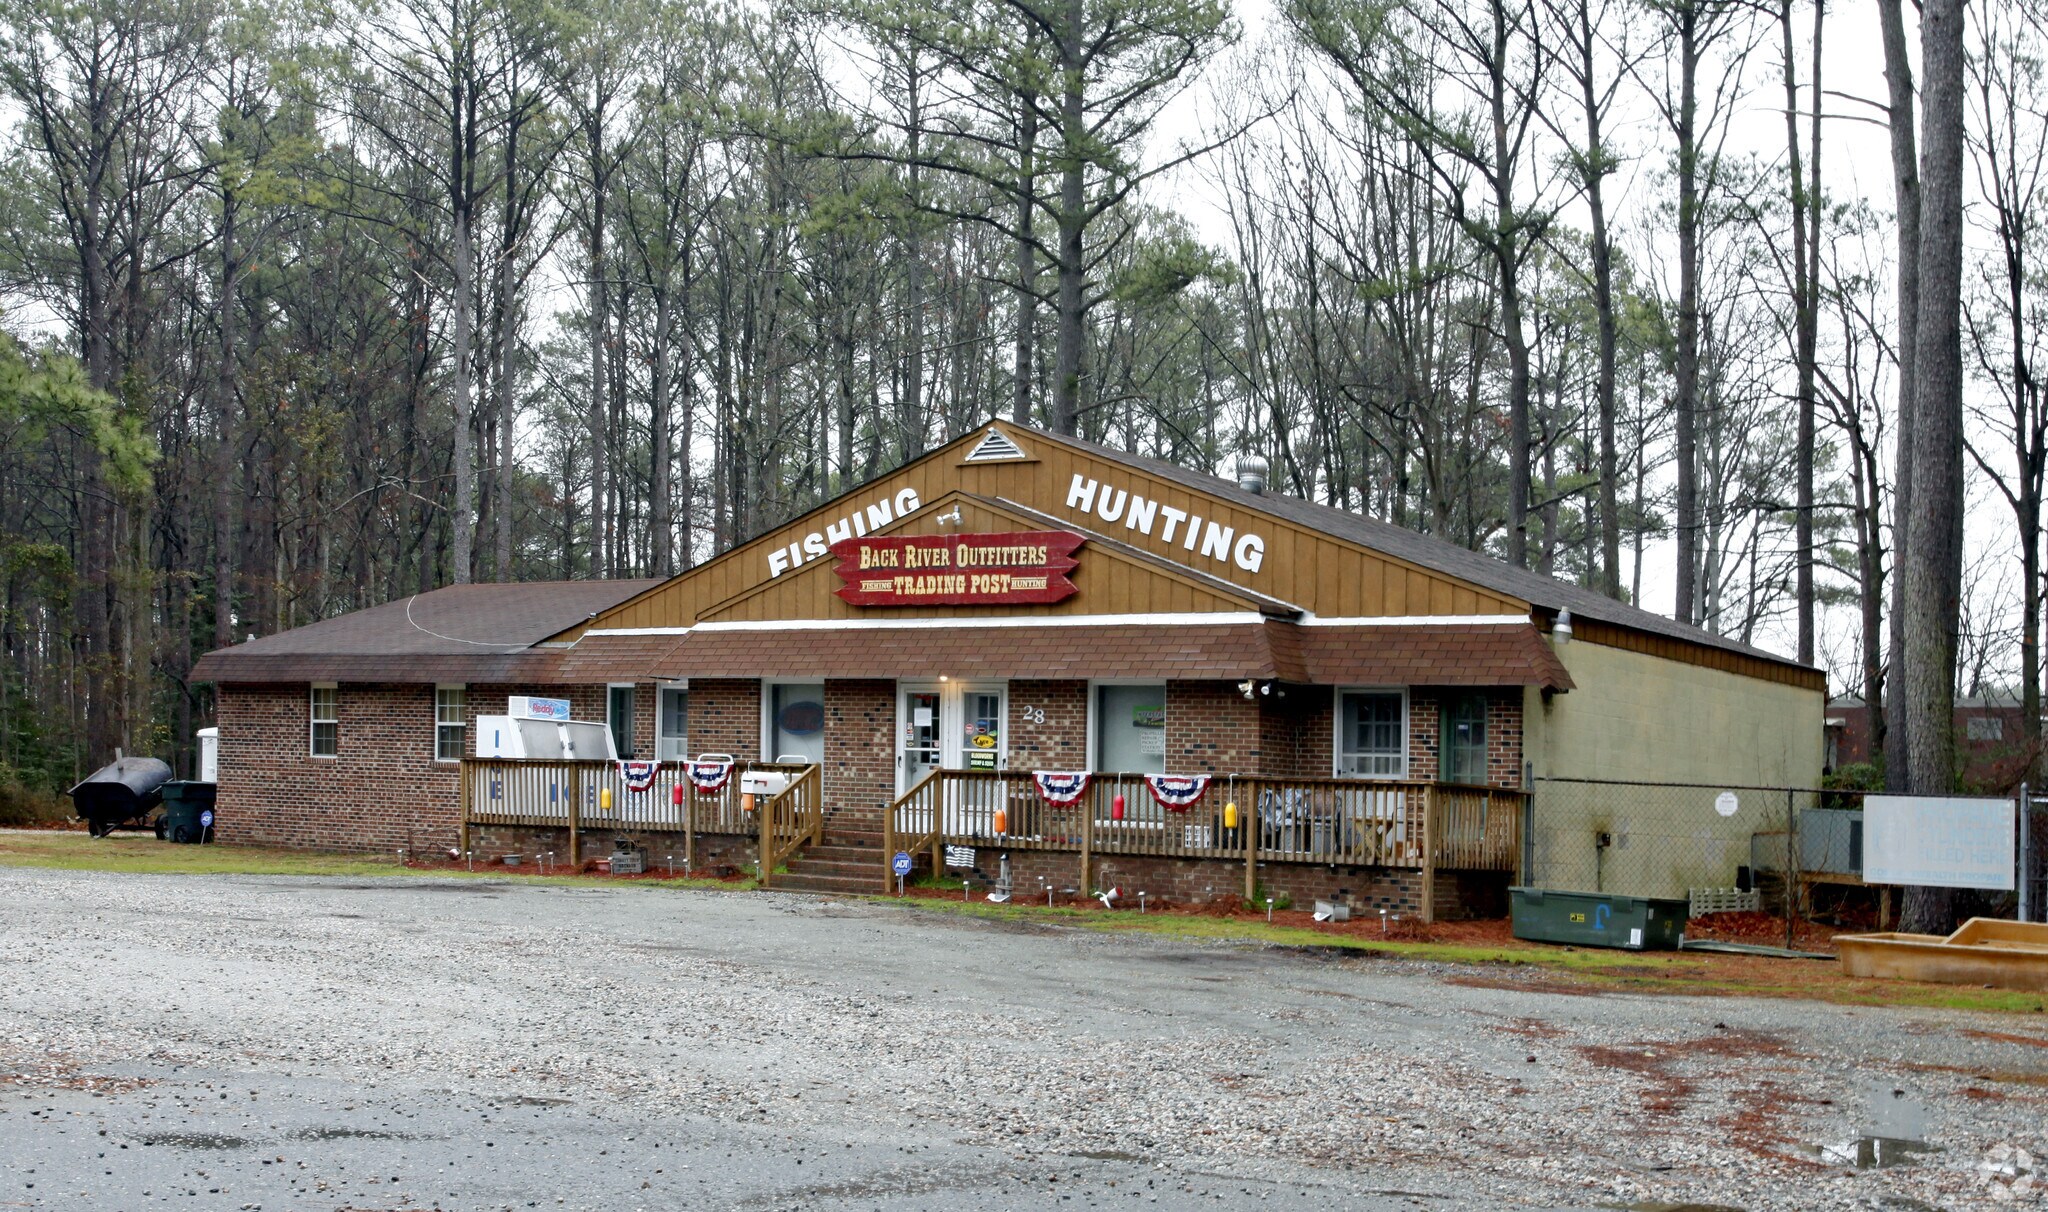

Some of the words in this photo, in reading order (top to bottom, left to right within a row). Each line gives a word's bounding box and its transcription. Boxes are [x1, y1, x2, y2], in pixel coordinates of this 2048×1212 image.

[767, 487, 920, 578] FISHING
[1066, 473, 1265, 573] HUNTING
[859, 545, 898, 569] BACK
[904, 544, 949, 568] RIVER
[956, 543, 1047, 567] OUTFITTERS
[861, 582, 892, 590] FISHING
[894, 574, 965, 595] TRADING
[970, 573, 1011, 593] POST
[1011, 578, 1047, 588] HUNTING
[1023, 705, 1045, 724] 28
[895, 859, 909, 868] ADT
